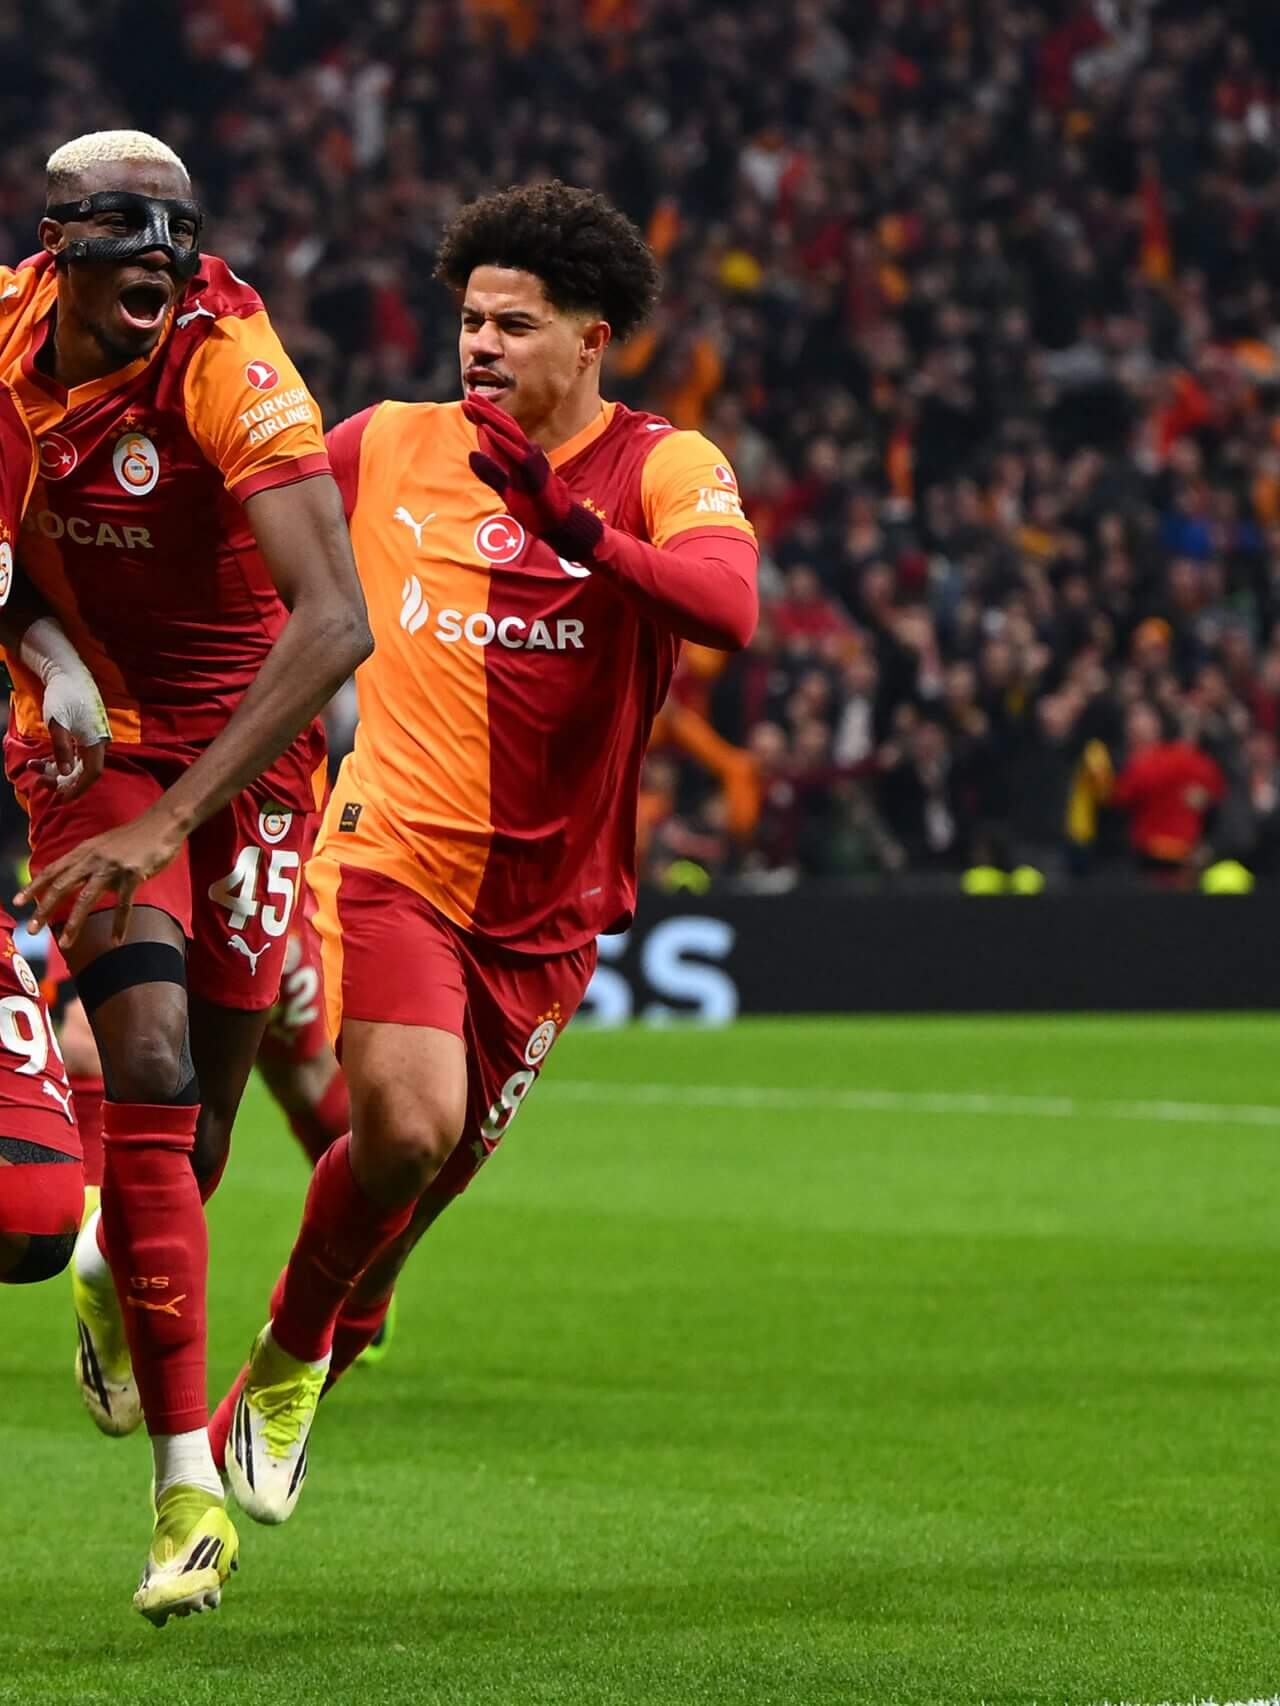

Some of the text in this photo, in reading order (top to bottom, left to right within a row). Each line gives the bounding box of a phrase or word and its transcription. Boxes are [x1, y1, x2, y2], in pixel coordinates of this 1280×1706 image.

[239, 387, 308, 428] TURKISH
[248, 403, 313, 445] AIRLINES
[24, 510, 155, 549] OCAR
[434, 608, 585, 650] SOCAR
[208, 845, 300, 937] 45
[130, 1275, 170, 1290] GS
